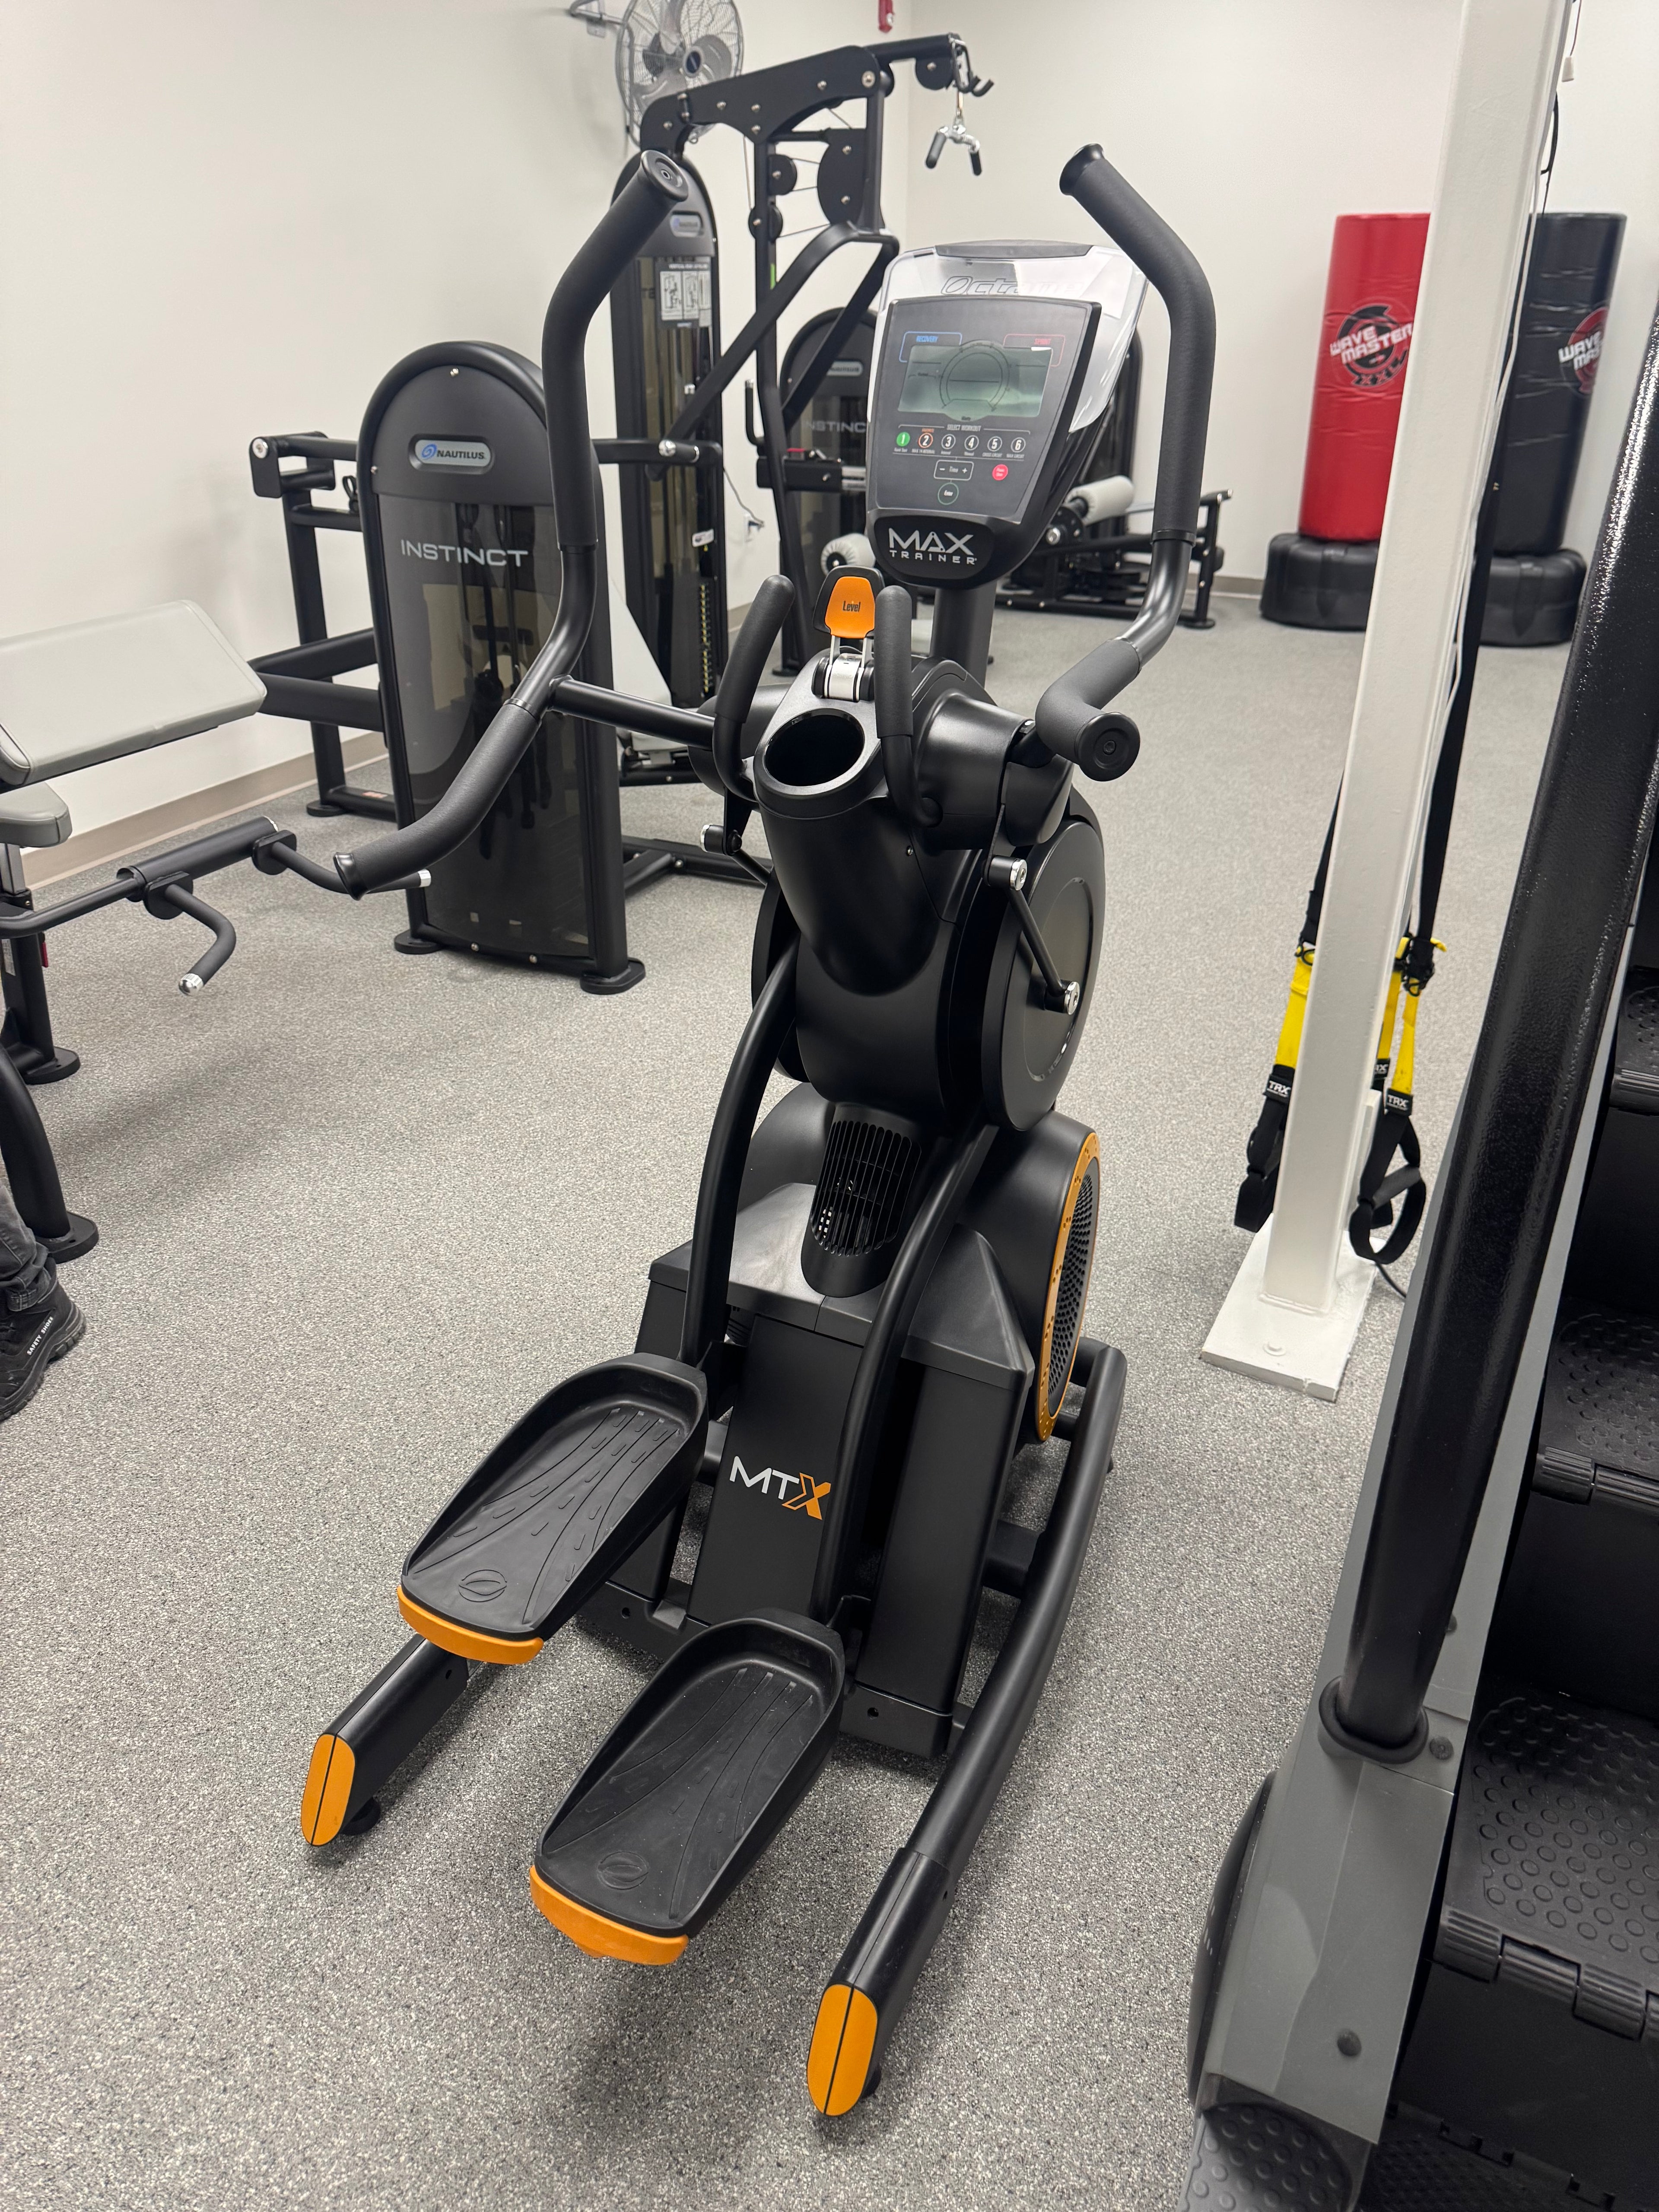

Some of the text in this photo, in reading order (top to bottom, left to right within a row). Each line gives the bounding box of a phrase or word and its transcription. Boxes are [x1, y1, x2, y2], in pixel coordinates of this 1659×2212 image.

[1329, 325, 1376, 357] WAVE
[1341, 323, 1413, 364] MASTER
[901, 434, 905, 444] 1
[922, 435, 929, 446] 2
[945, 436, 952, 447] 3
[968, 437, 975, 448] 4
[991, 439, 998, 449] 5
[1015, 439, 1022, 450] 6
[436, 450, 485, 459] NAUTILUS
[889, 528, 974, 556] MAX
[401, 539, 528, 567] INSTINCT
[889, 550, 975, 565] TRAINER
[842, 601, 861, 612] Level
[1269, 1080, 1291, 1094] TRX
[1387, 1094, 1409, 1108] TRX
[27, 1334, 42, 1355] SAFETY
[729, 1456, 831, 1520] MTX
